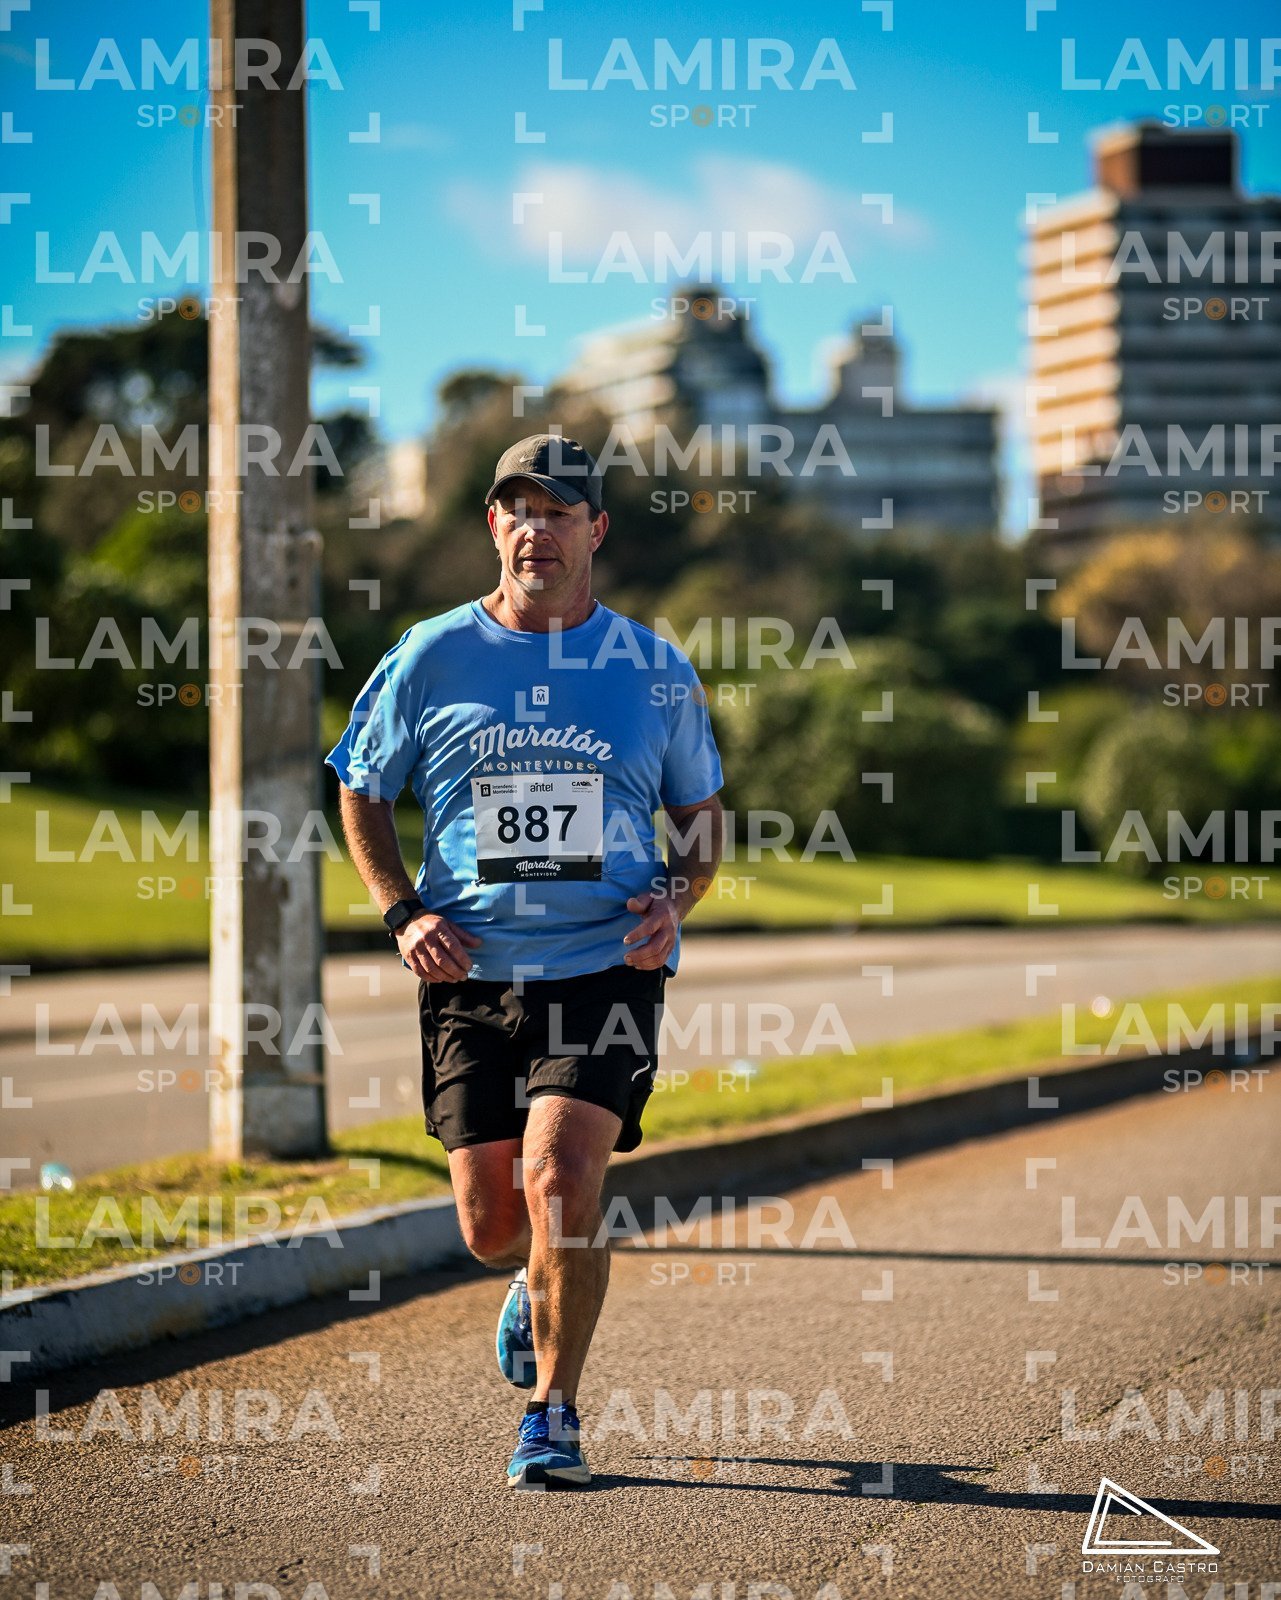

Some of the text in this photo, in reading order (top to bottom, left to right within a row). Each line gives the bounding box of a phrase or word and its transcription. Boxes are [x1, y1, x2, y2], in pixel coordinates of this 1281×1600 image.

[469, 722, 613, 761] Maratón
[482, 760, 597, 772] MONTEVIDEO
[530, 782, 554, 793] antel
[497, 804, 578, 844] 887
[516, 860, 562, 872] Maratón
